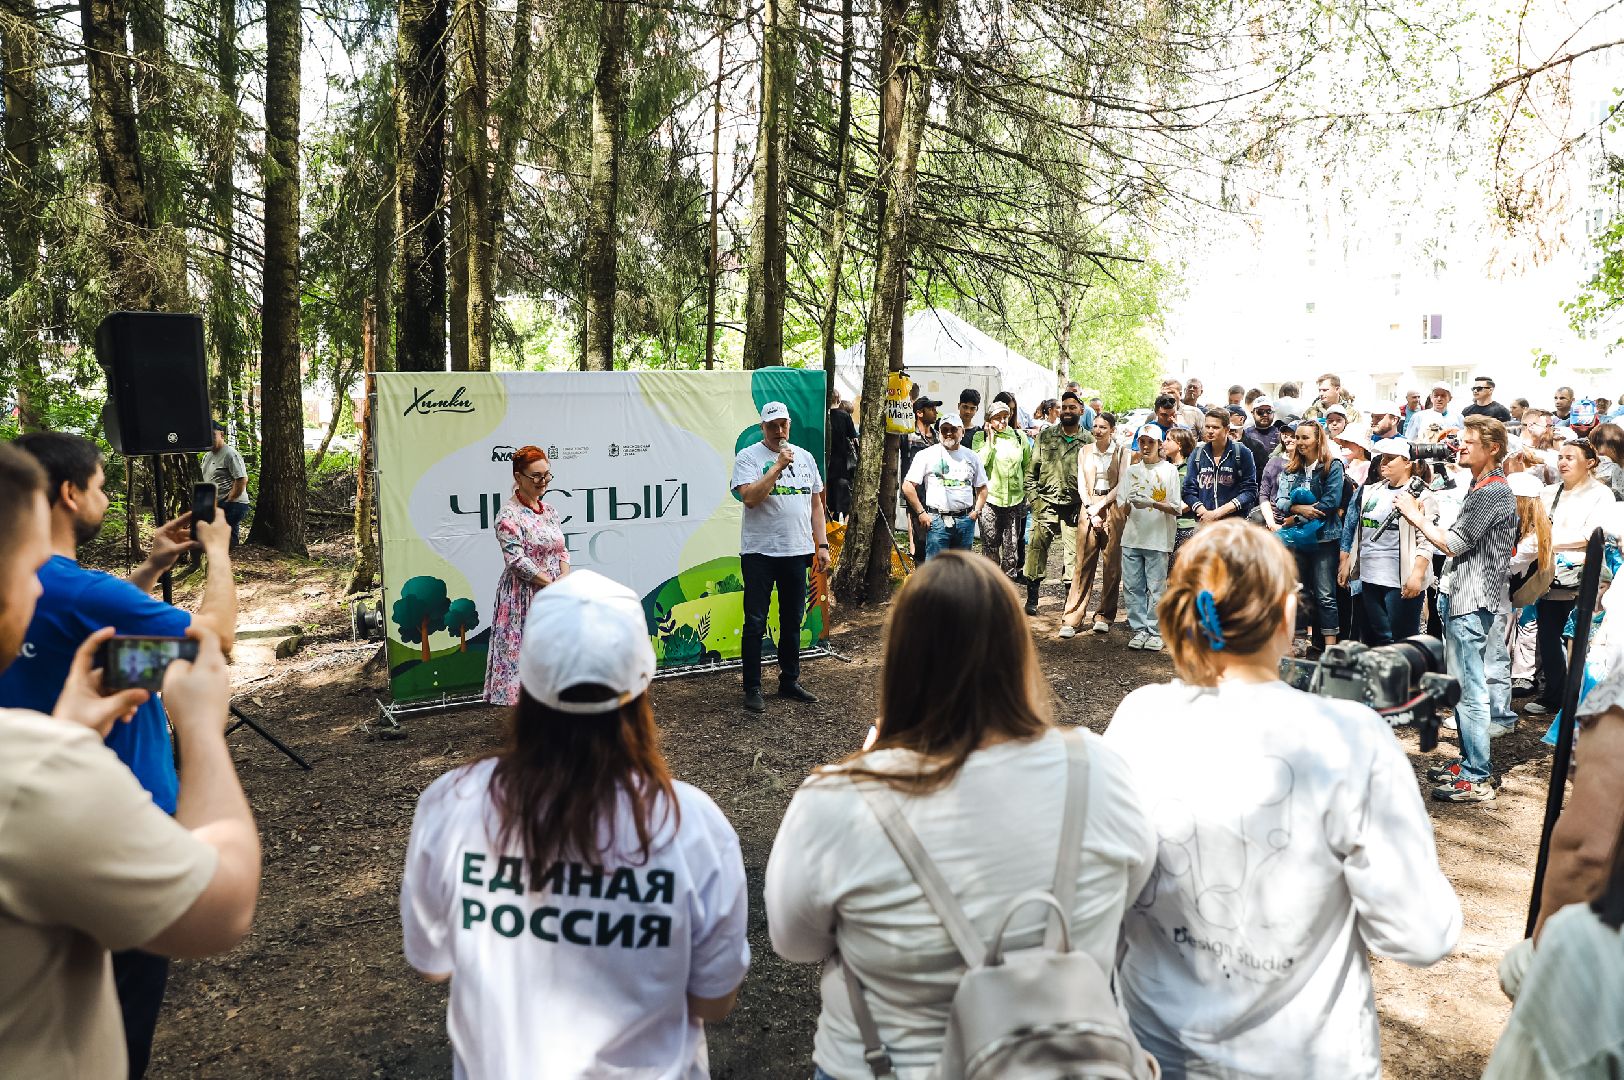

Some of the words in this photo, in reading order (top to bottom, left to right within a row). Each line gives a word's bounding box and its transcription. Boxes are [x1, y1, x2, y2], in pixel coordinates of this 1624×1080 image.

[403, 386, 475, 416] Химки
[564, 529, 625, 567] ЕС
[462, 897, 672, 949] РОССИЯ
